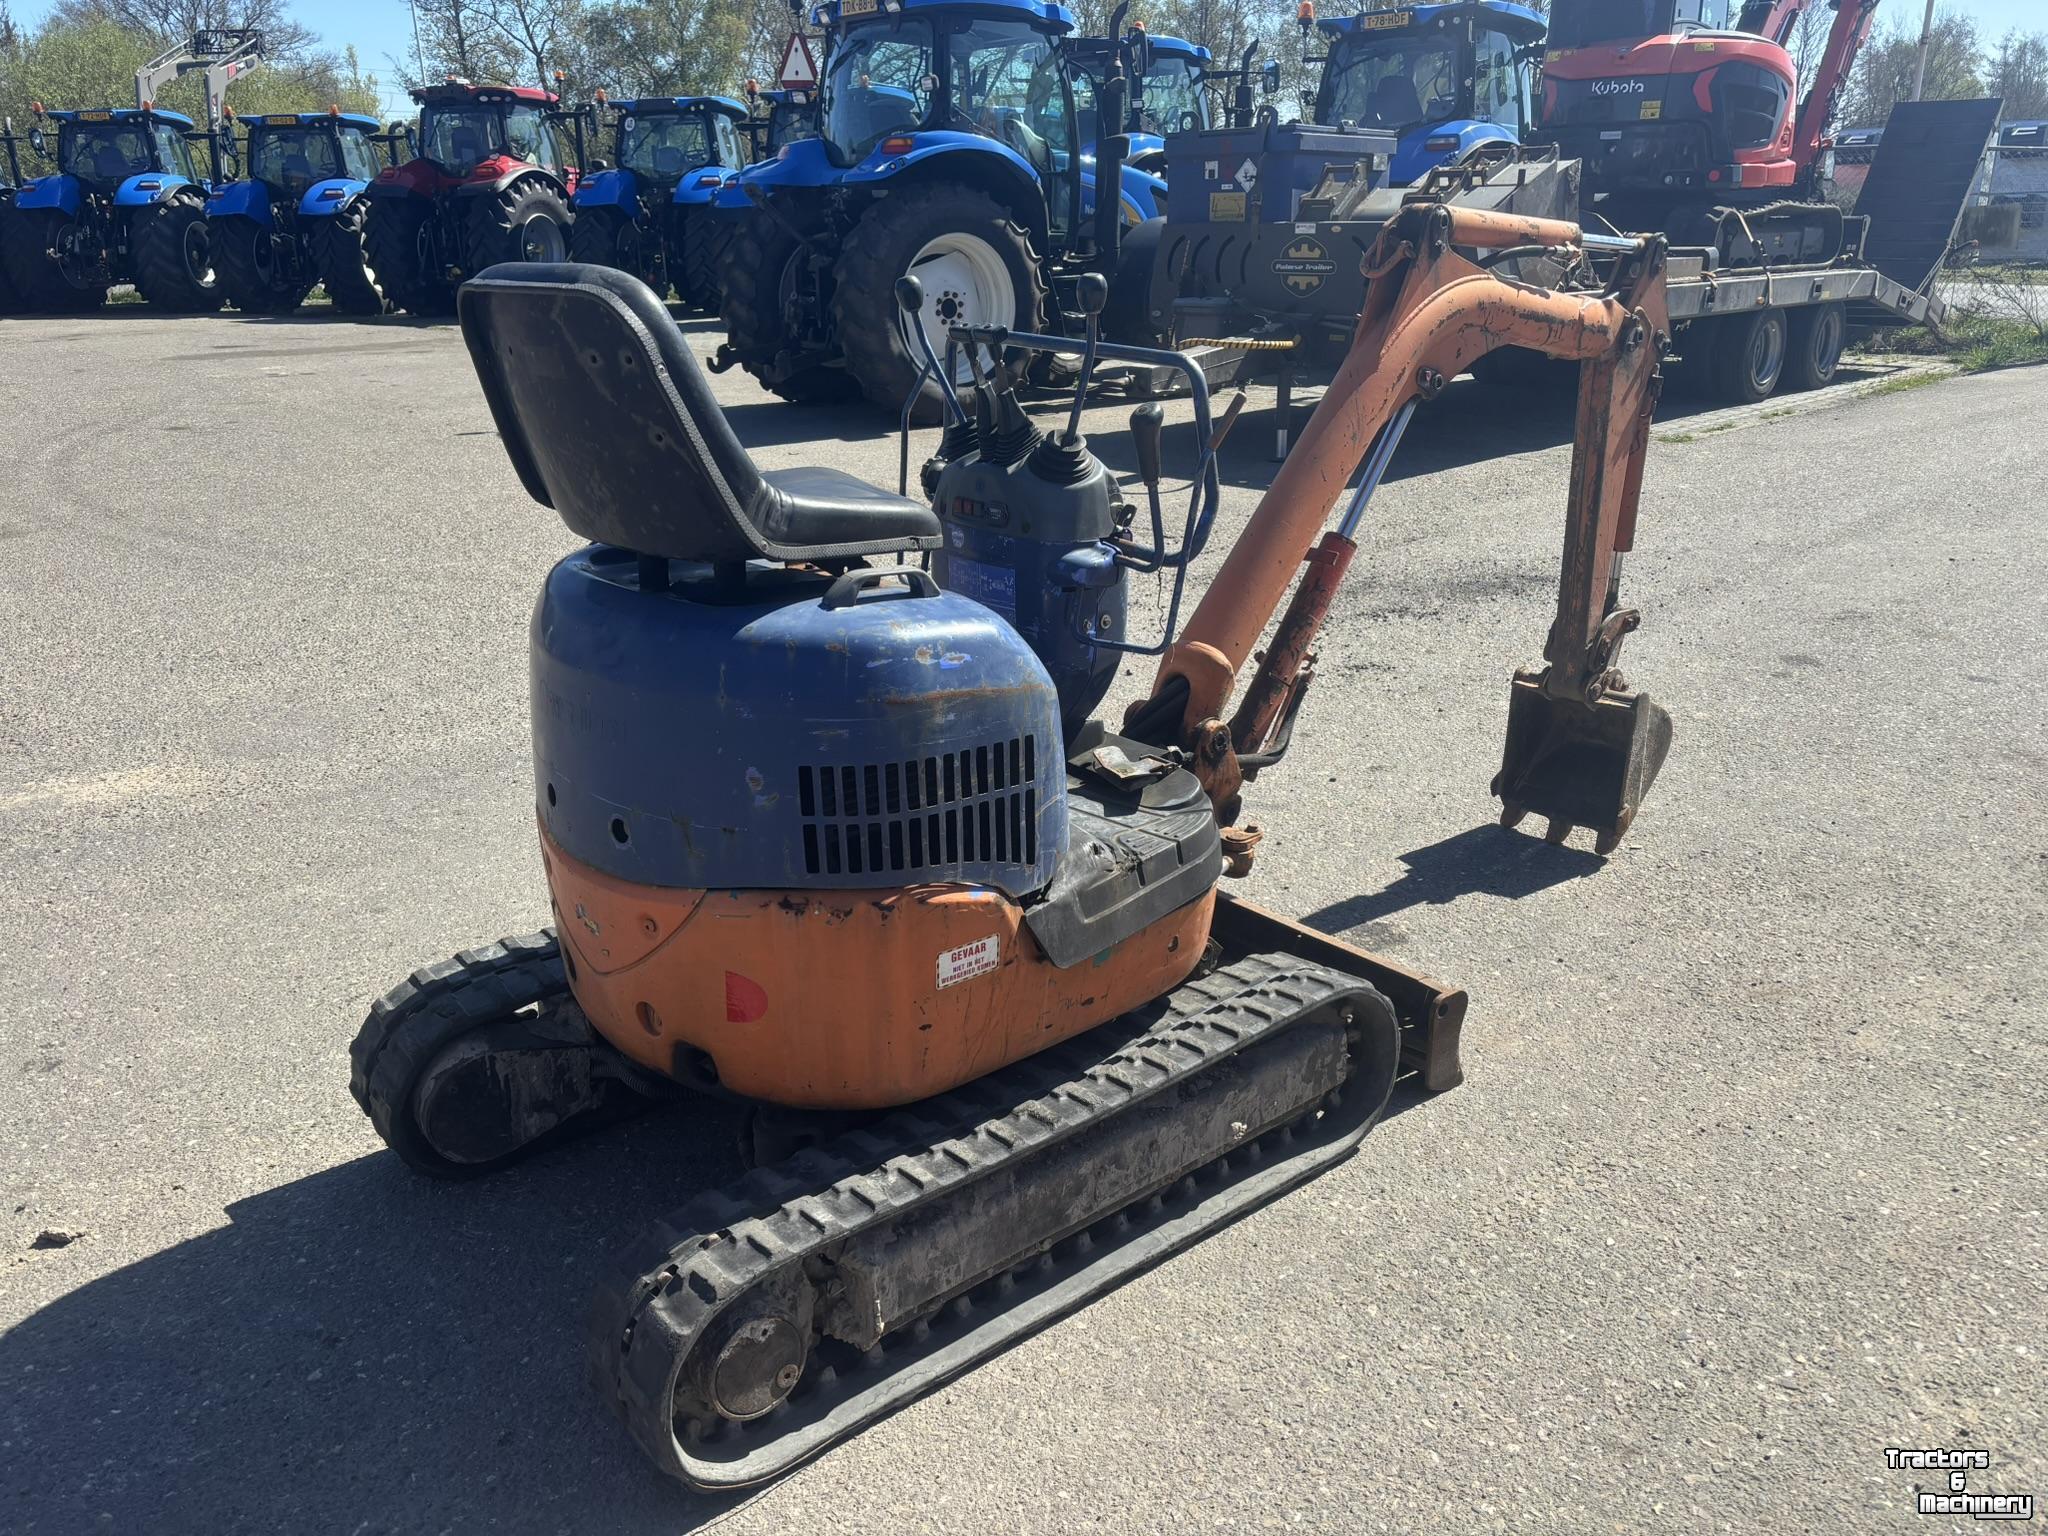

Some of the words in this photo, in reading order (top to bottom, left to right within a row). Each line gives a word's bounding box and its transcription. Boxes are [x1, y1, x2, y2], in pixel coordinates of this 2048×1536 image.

[1366, 13, 1407, 28] T-78-HDF
[1591, 79, 1645, 95] Kubota
[951, 942, 987, 963] GEVAAR
[941, 967, 976, 984] WERKGEBIED
[976, 960, 996, 972] KOMEN
[952, 963, 965, 973] NIET
[974, 956, 985, 966] HET
